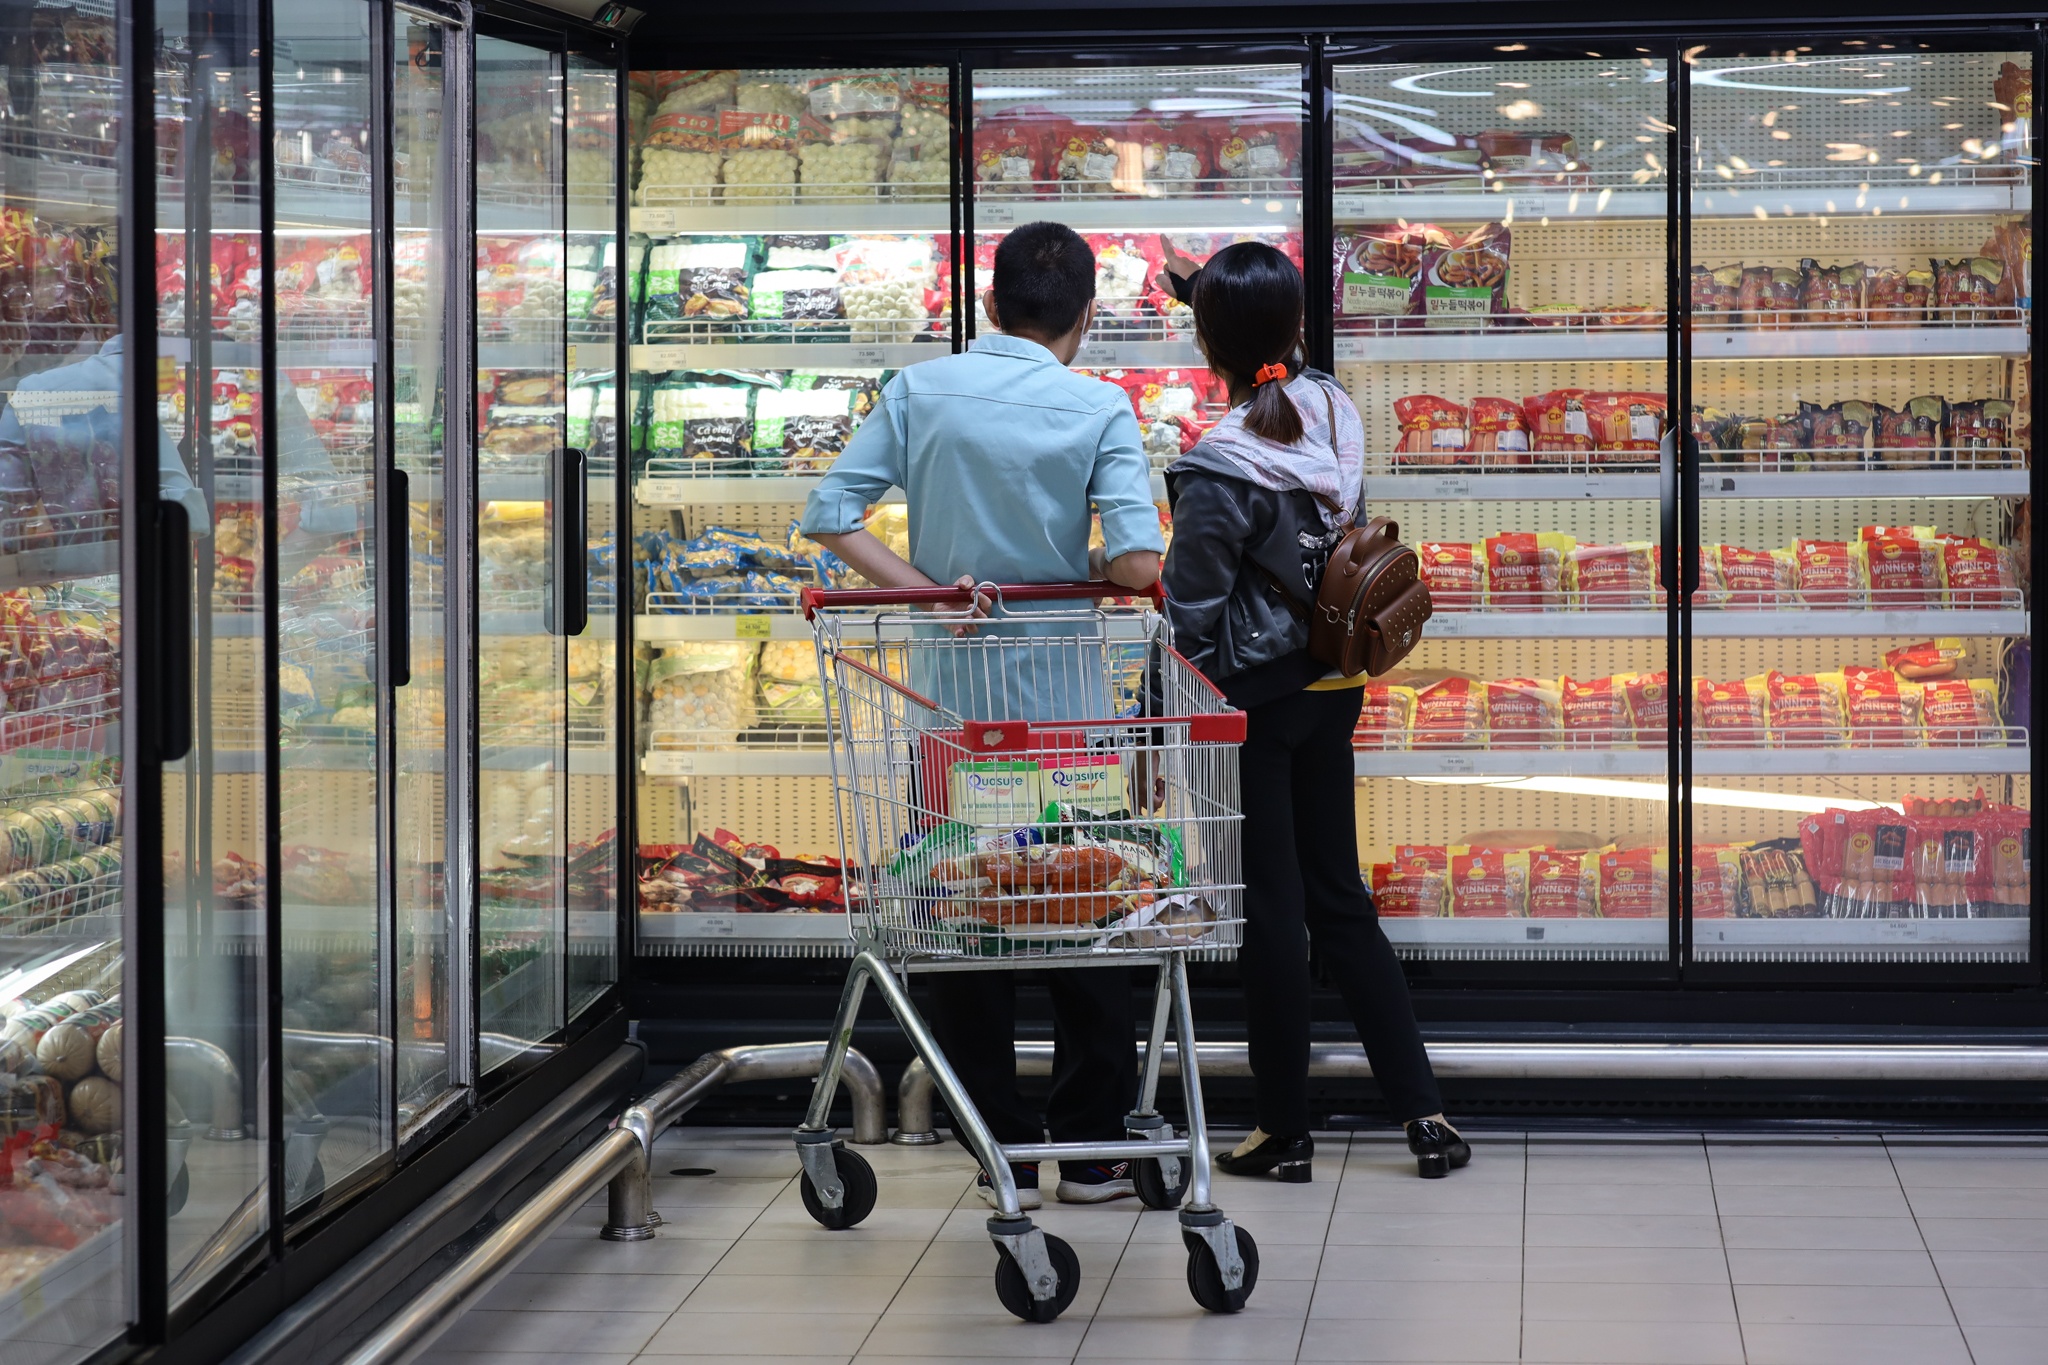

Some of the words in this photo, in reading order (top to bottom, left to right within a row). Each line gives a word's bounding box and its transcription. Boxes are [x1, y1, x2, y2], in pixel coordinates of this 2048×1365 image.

[1068, 141, 1085, 152] CP
[1548, 413, 1562, 421] CP
[1504, 555, 1518, 563] CP
[1423, 565, 1467, 577] WINNER
[1492, 566, 1535, 577] WINNER
[1723, 566, 1769, 577] WINNER
[1872, 562, 1915, 575] WINNER
[1644, 687, 1658, 697] CP
[1421, 701, 1460, 710] WINNER
[1491, 703, 1533, 713] WINNER
[1564, 701, 1606, 710] WINNER
[1773, 697, 1814, 709] WINNER
[1852, 702, 1894, 711] WINNER
[1637, 703, 1668, 718] WINNE
[1703, 704, 1744, 715] WINNER
[969, 774, 1024, 790] Quasure
[1052, 771, 1108, 786] Quasure
[1853, 838, 1869, 849] CP
[2001, 844, 2017, 854] CP
[1376, 886, 1416, 896] WINNER
[1456, 886, 1500, 896] WINNER
